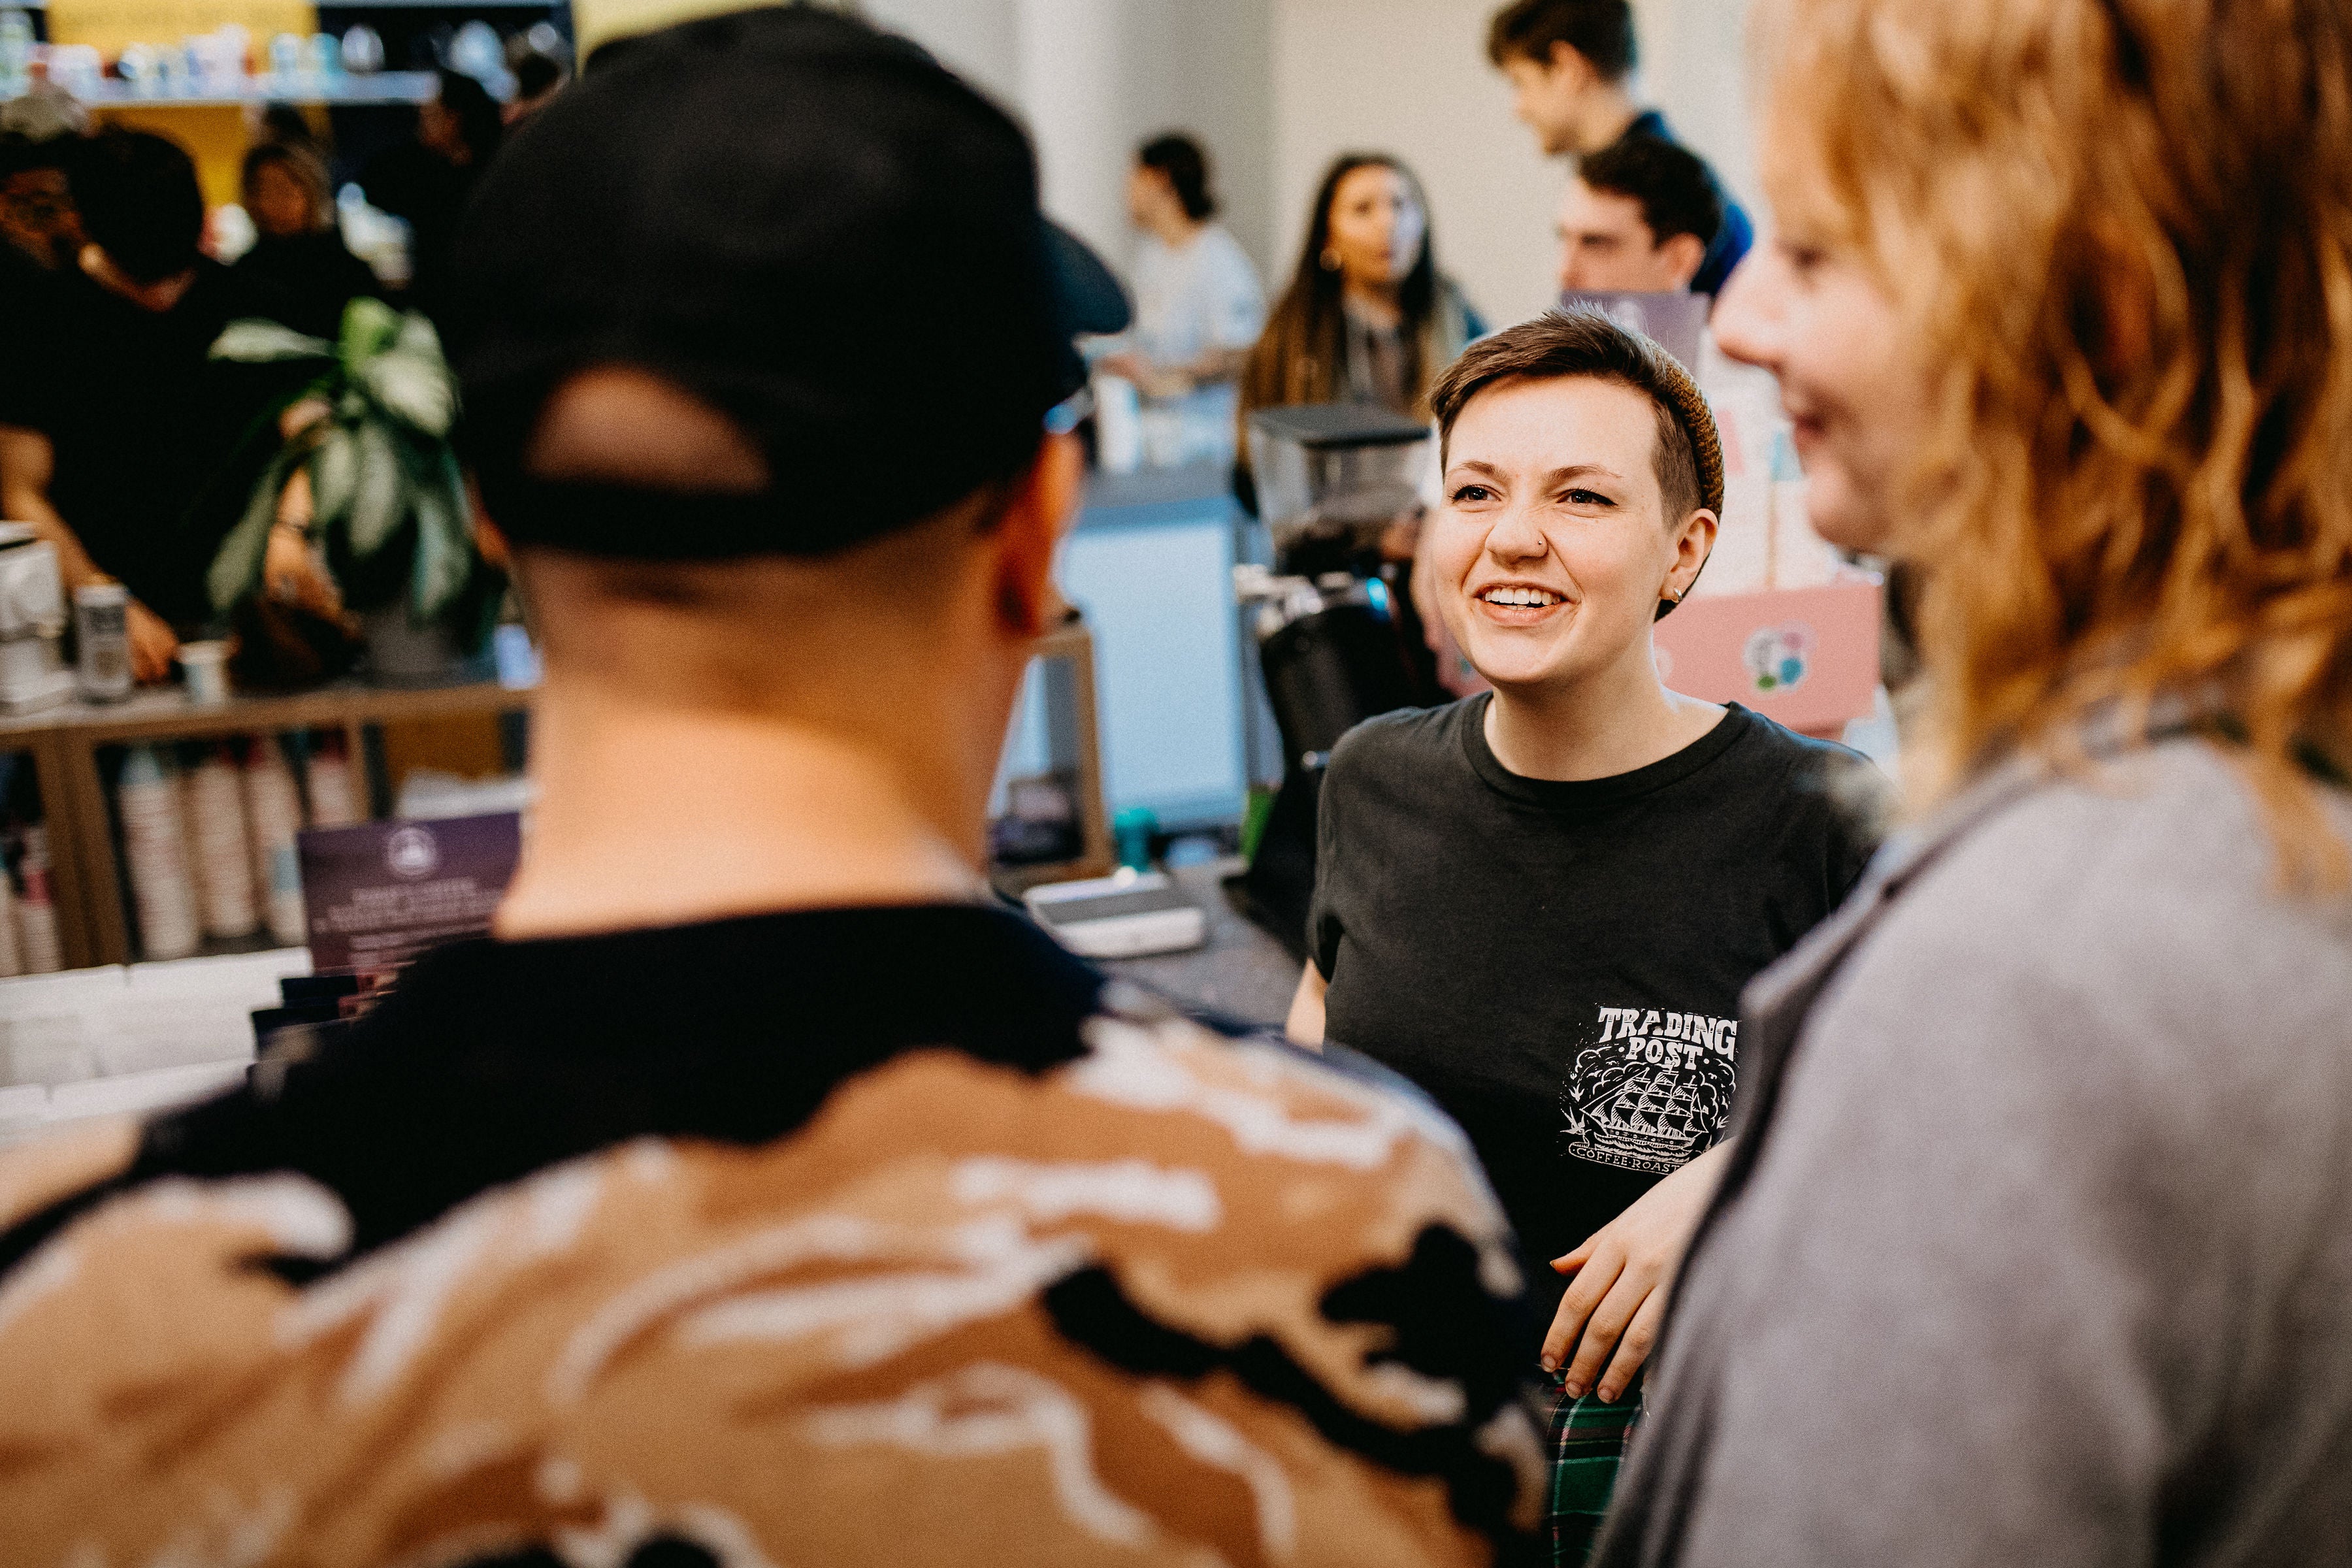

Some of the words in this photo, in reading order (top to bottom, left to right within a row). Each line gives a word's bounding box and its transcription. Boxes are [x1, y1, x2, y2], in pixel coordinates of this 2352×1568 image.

[1598, 1007, 1737, 1062] TRADING
[1625, 1037, 1704, 1070] POST
[1576, 1147, 1627, 1166] COFFEE
